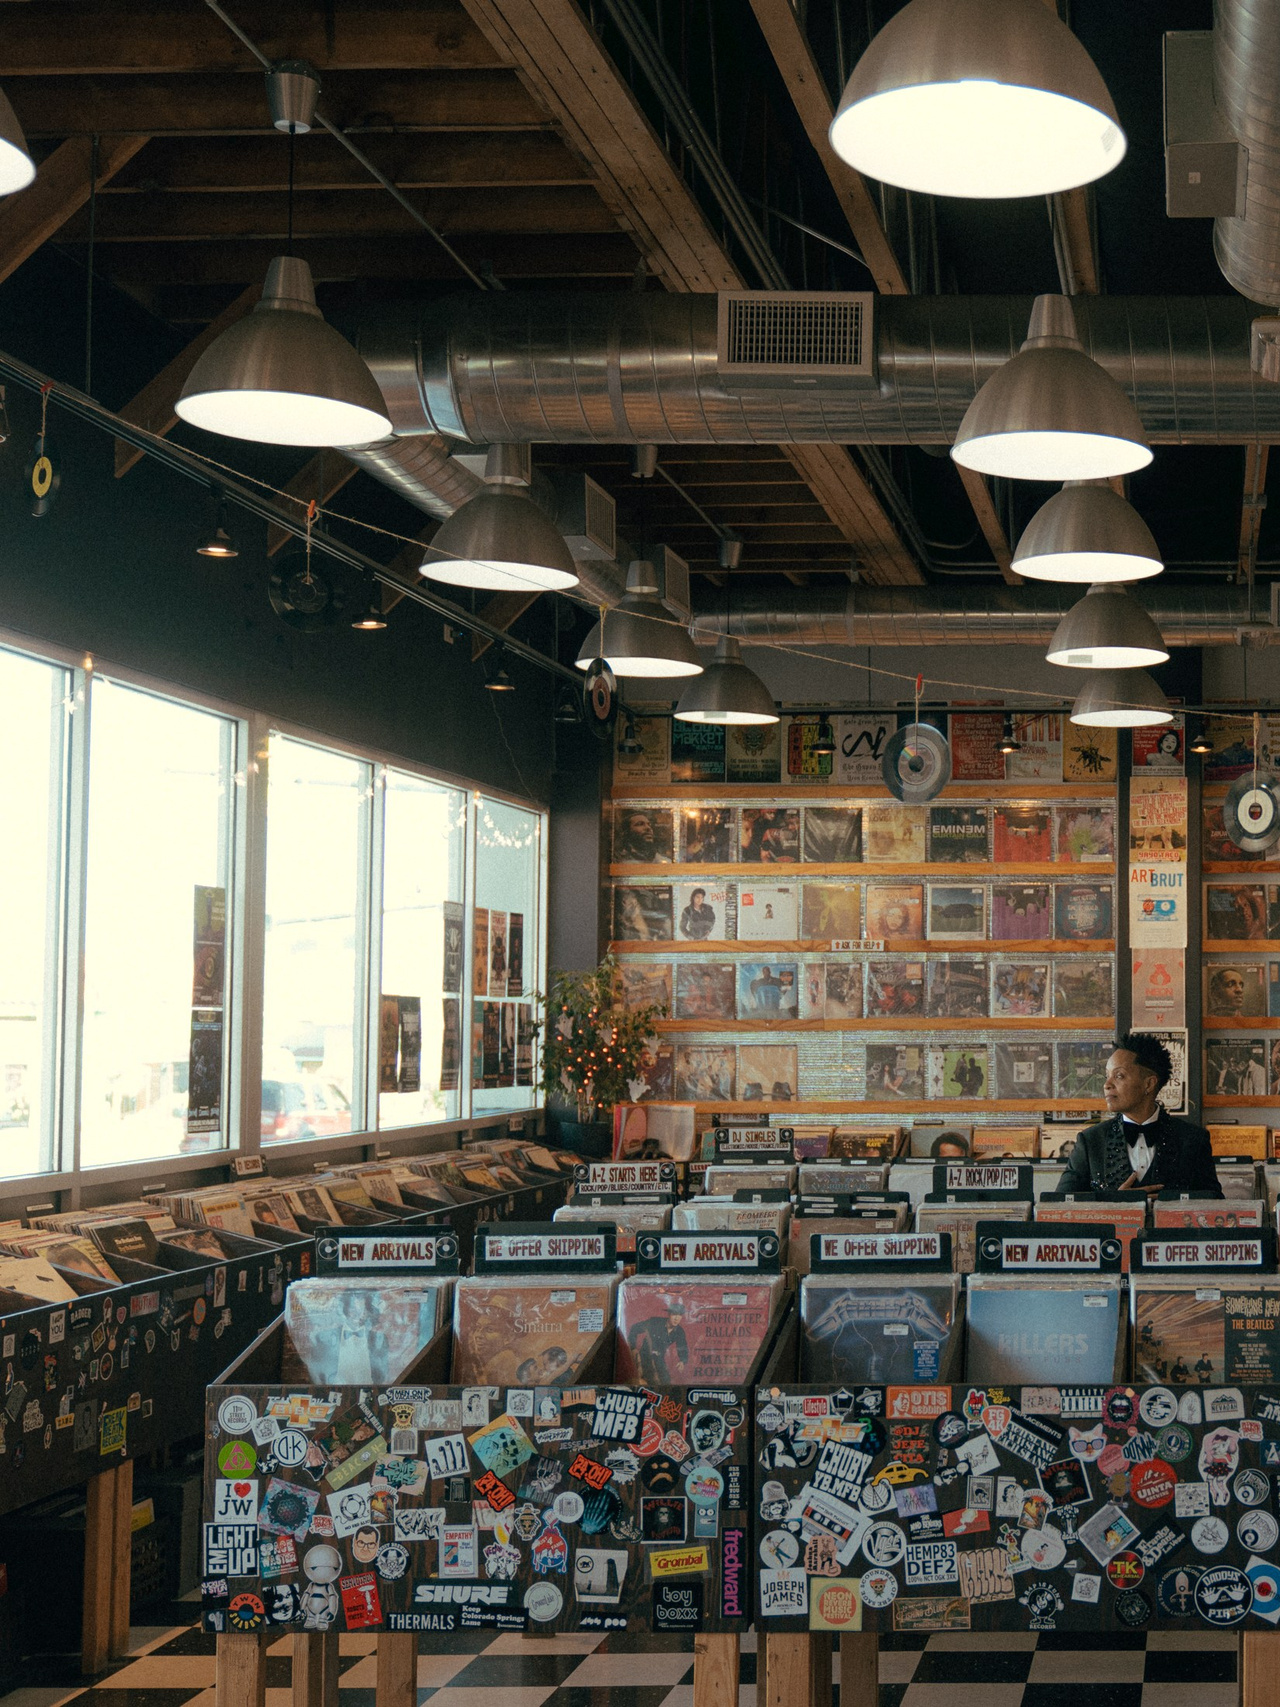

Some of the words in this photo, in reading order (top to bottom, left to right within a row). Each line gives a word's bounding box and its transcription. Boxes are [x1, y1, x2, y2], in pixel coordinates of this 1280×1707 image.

[1131, 869, 1155, 883] ART
[1151, 873, 1184, 887] BRUT
[842, 940, 851, 949] ASK
[853, 940, 861, 949] FOR
[863, 940, 875, 949] HELP
[732, 1131, 742, 1143] DJ
[745, 1131, 777, 1143] SINGLES
[592, 1167, 606, 1183] A-Z
[609, 1166, 636, 1183] STARTS
[638, 1165, 658, 1182] HERE
[948, 1168, 963, 1187] A-Z
[965, 1167, 1017, 1188] ROCK/POP/ETC
[1062, 1212, 1072, 1221] 4
[1074, 1214, 1122, 1222] SEASONS
[341, 1243, 365, 1261] NEW
[372, 1242, 434, 1261] ARRIVALS
[489, 1239, 503, 1257] WE
[509, 1239, 542, 1257] OFFER
[548, 1237, 602, 1257] SHIPPING
[664, 1243, 687, 1261] NEW
[694, 1242, 756, 1261] ARRIVALS
[824, 1239, 839, 1257] WE
[844, 1238, 878, 1256] OFFER
[883, 1237, 937, 1256] SHIPPING
[1006, 1244, 1029, 1263] NEW
[1036, 1243, 1098, 1263] ARRIVALS
[1145, 1245, 1160, 1262] WE
[1165, 1244, 1199, 1262] OFFER
[1204, 1243, 1258, 1261] SHIPPING
[1265, 1297, 1280, 1307] NEW
[695, 1313, 762, 1324] GUNFIGHTER
[1264, 1305, 1280, 1317] NEW
[51, 1326, 63, 1335] YOU
[513, 1318, 563, 1334] Sinatra
[705, 1327, 752, 1338] BALLADS
[1232, 1320, 1245, 1330] THE
[1246, 1319, 1275, 1330] BEATLES
[998, 1333, 1090, 1355] KILLERS
[596, 1393, 647, 1415] CHUBY
[911, 1390, 948, 1406] OTIS
[592, 1411, 639, 1441] MFB
[818, 1440, 874, 1485] CHUBY
[225, 1483, 232, 1498] I
[1137, 1481, 1174, 1499] UINTA
[218, 1499, 253, 1516] JW
[445, 1532, 473, 1540] EMPATHY
[907, 1543, 955, 1561] HEMP83
[228, 1549, 256, 1575] UP
[907, 1558, 957, 1576] DEF2
[1112, 1561, 1138, 1575] TK
[724, 1529, 744, 1616] fredward
[415, 1585, 509, 1605] SHURE
[662, 1587, 693, 1605] toy
[763, 1580, 805, 1596] JOSEPH
[823, 1591, 852, 1600] NEON
[233, 1595, 261, 1610] TWIN
[765, 1591, 803, 1609] JAMES
[462, 1605, 481, 1613] Keep
[656, 1605, 698, 1620] boxx
[823, 1606, 852, 1614] MUSIC
[229, 1612, 262, 1630] SHADOW
[389, 1613, 454, 1630] THERMALS
[461, 1619, 481, 1627] Lame
[462, 1612, 496, 1621] Colorado
[497, 1614, 525, 1623] Springs
